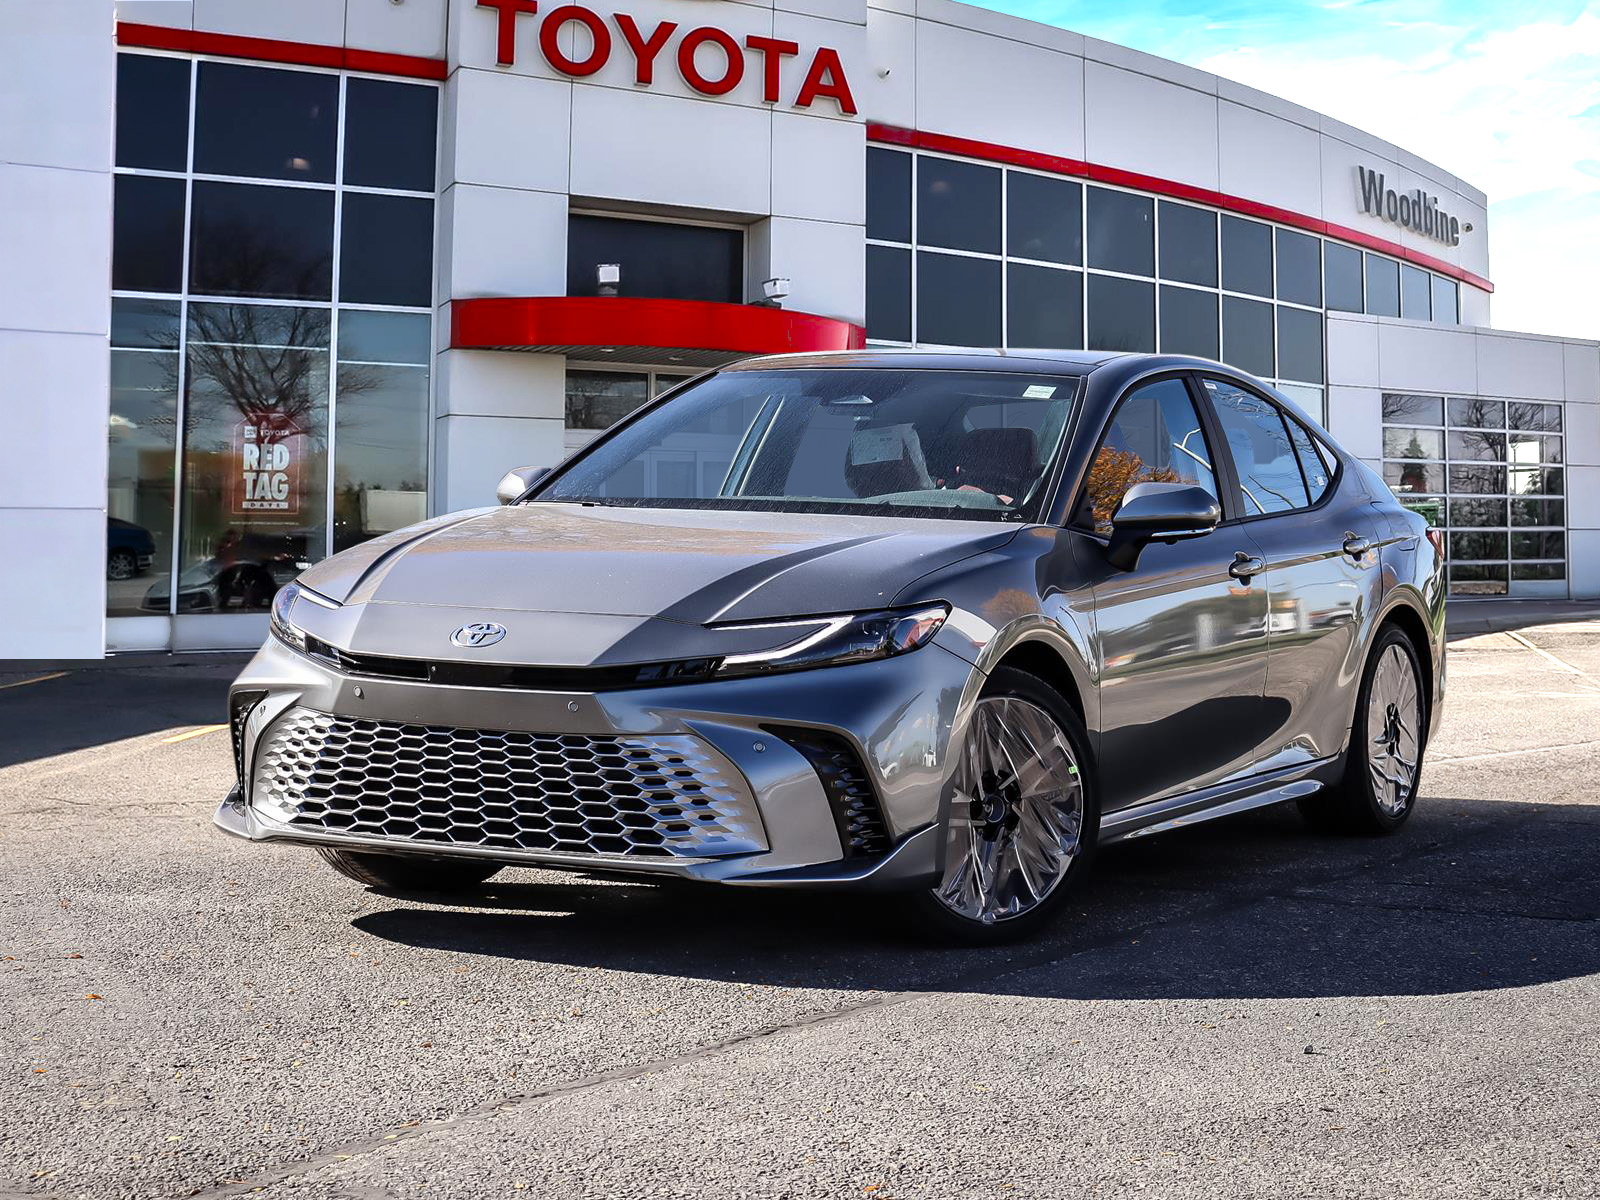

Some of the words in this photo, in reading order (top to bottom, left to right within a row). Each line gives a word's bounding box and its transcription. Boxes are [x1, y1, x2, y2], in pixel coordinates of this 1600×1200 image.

[476, 0, 858, 116] TOYOTA
[1357, 165, 1460, 247] Woodbine
[260, 429, 290, 437] TOYOTA
[243, 443, 290, 471] RED
[243, 472, 289, 500] TAG
